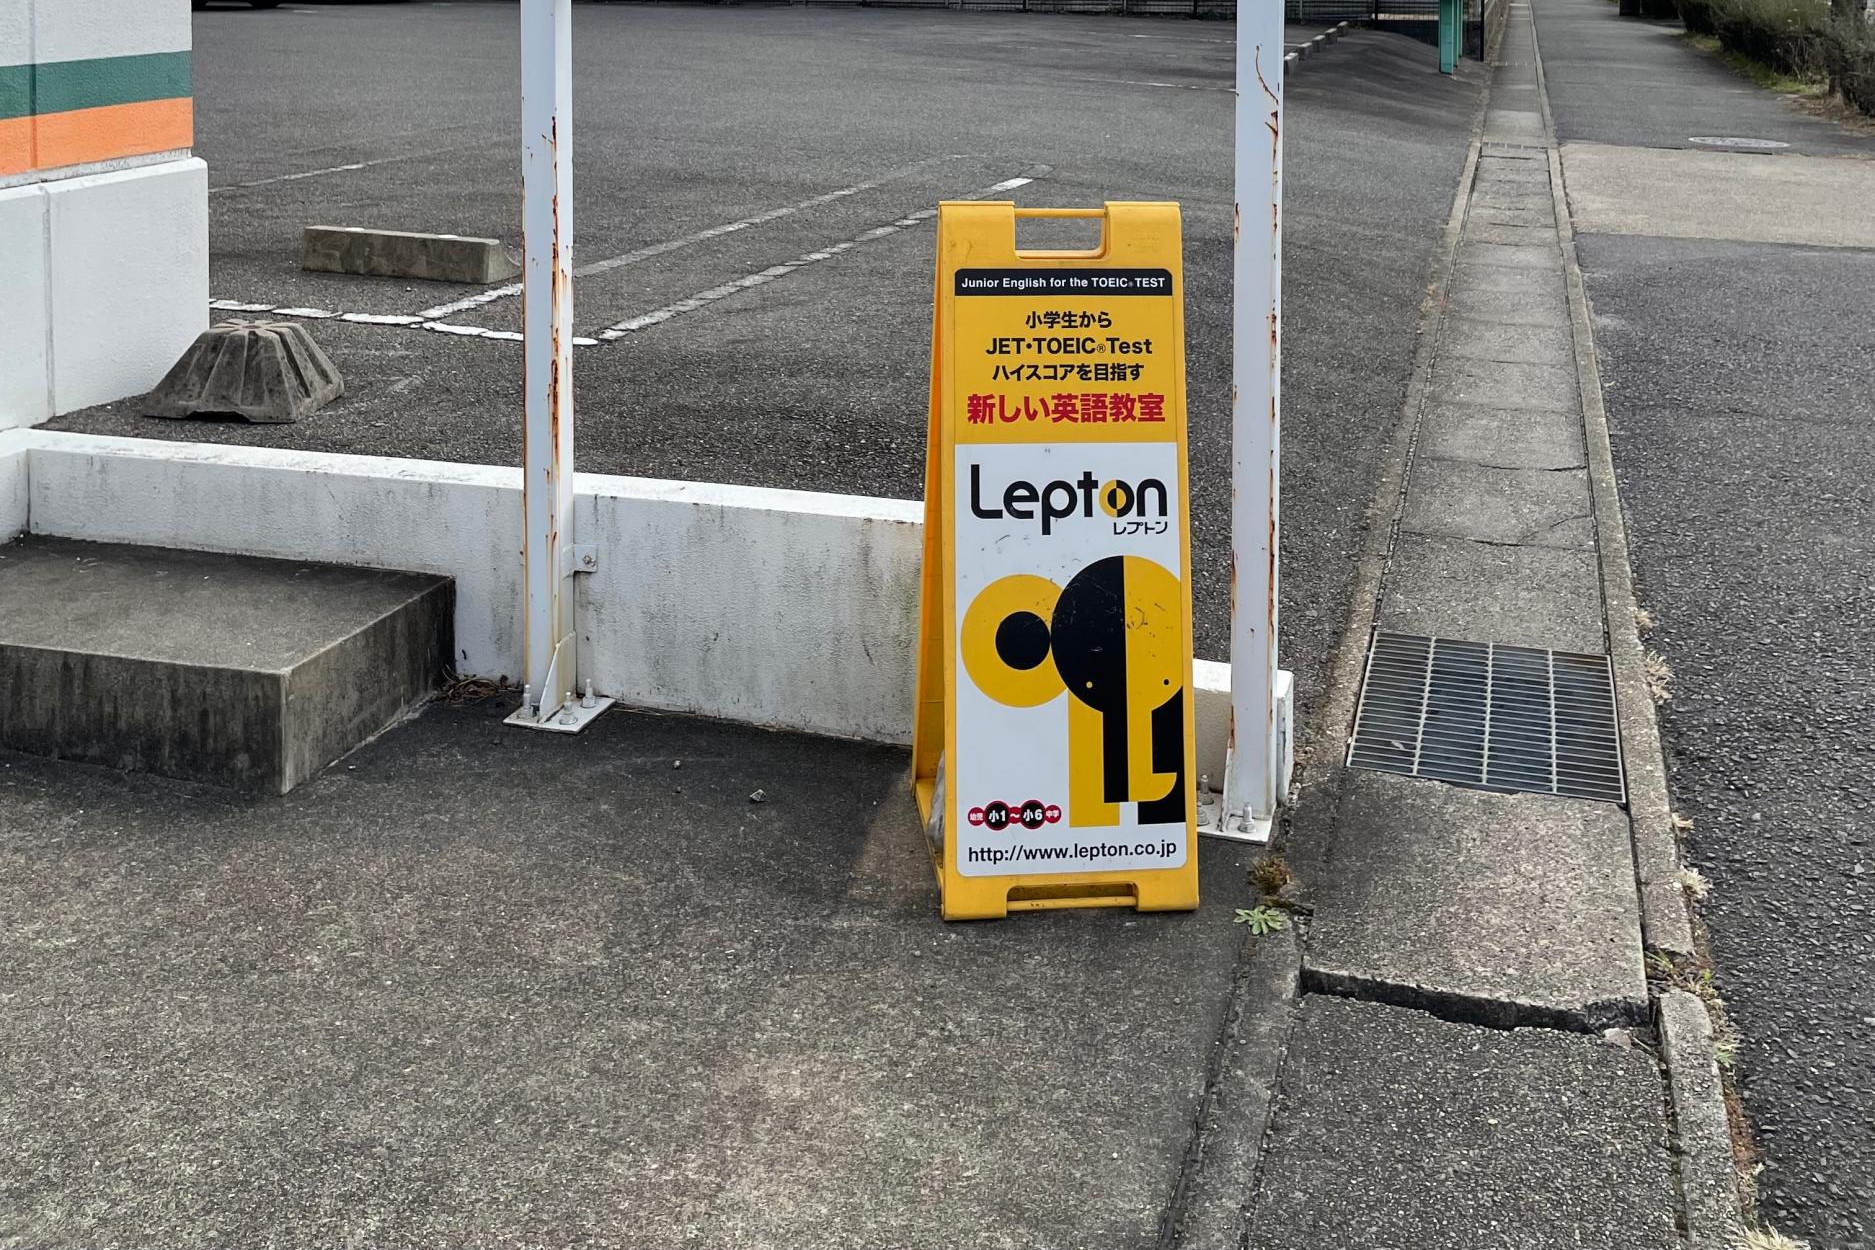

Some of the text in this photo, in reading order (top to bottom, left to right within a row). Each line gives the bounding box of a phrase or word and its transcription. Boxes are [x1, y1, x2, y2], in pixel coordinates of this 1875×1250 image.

[961, 277, 998, 288] Junior
[1002, 277, 1046, 289] English
[1050, 277, 1066, 287] for
[1069, 277, 1088, 287] the
[1025, 311, 1112, 328] 小学生から
[992, 363, 1144, 381] ハイスコアを目指す
[967, 392, 1166, 425] 新しい英語教室
[970, 463, 1168, 535] Lepton
[1113, 521, 1168, 536] レプトン
[968, 839, 1177, 865] http://www.lepton.co.jp
